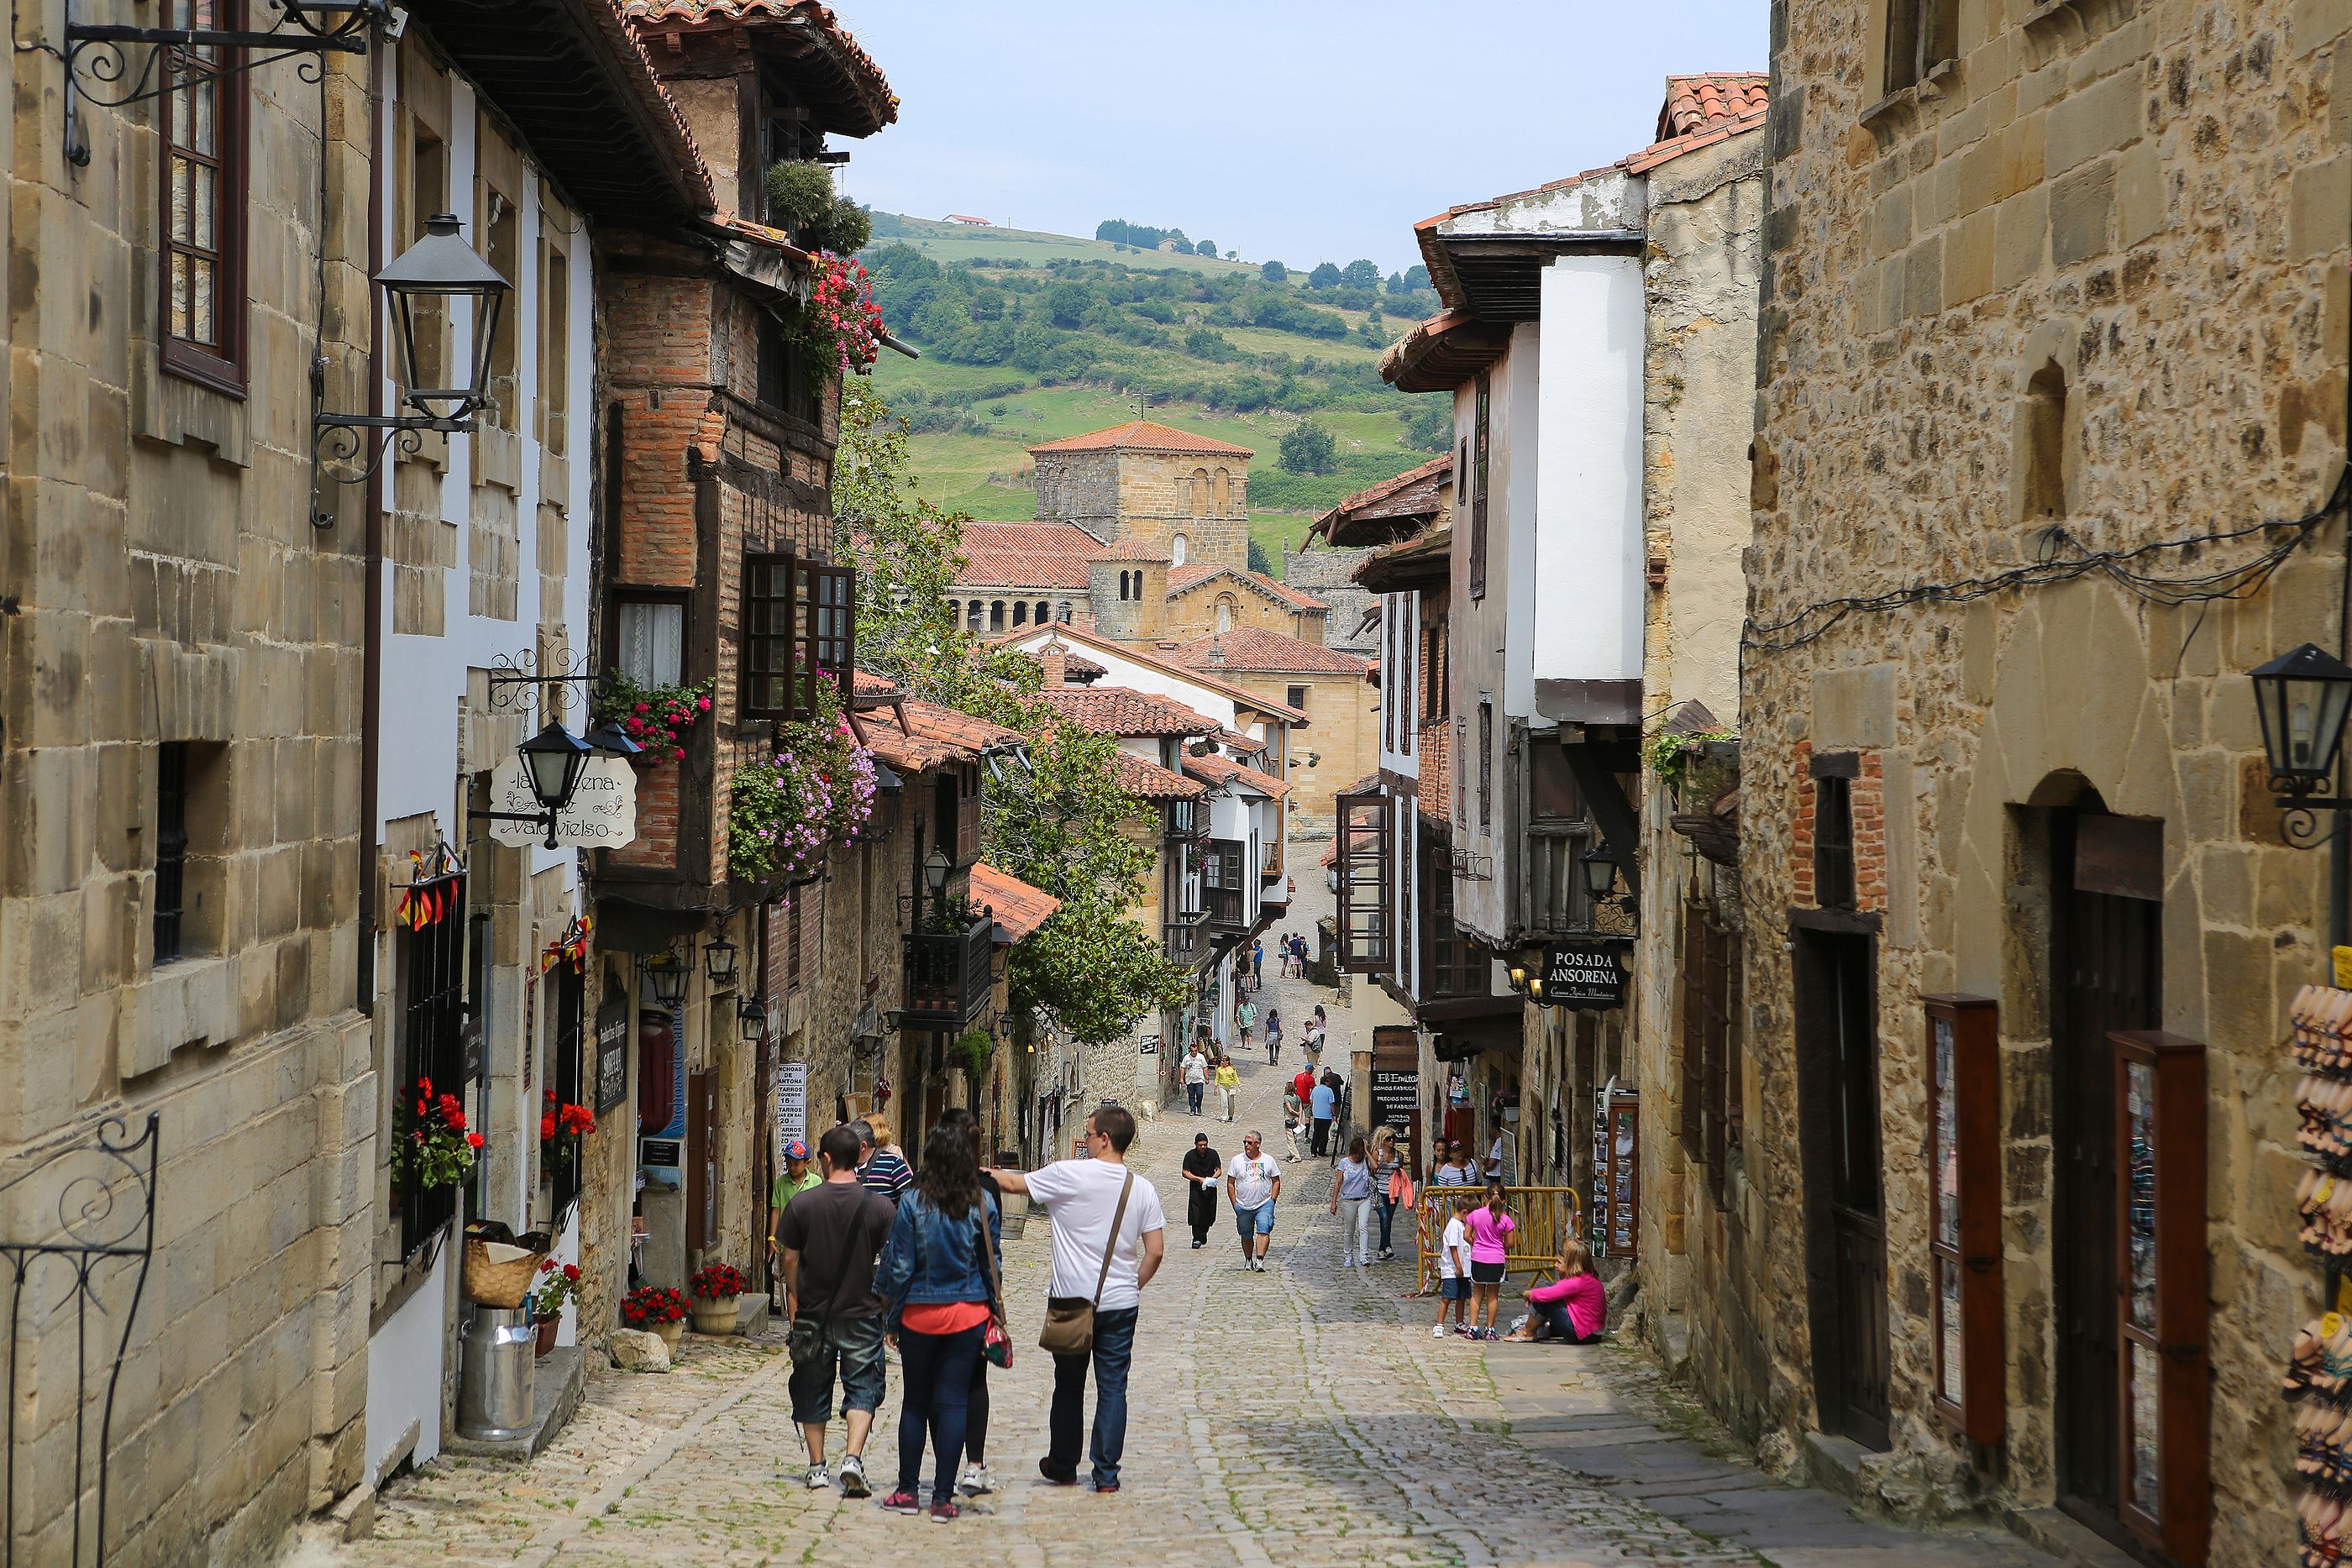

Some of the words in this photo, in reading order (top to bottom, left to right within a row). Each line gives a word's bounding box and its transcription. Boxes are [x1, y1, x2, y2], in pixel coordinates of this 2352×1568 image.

[1555, 952, 1613, 968] POSADA
[1549, 968, 1618, 984] ANSORENA
[669, 1008, 683, 1048] Santo
[666, 1053, 683, 1070] de
[1377, 1072, 1390, 1083] El
[666, 1075, 683, 1132] Anchoas
